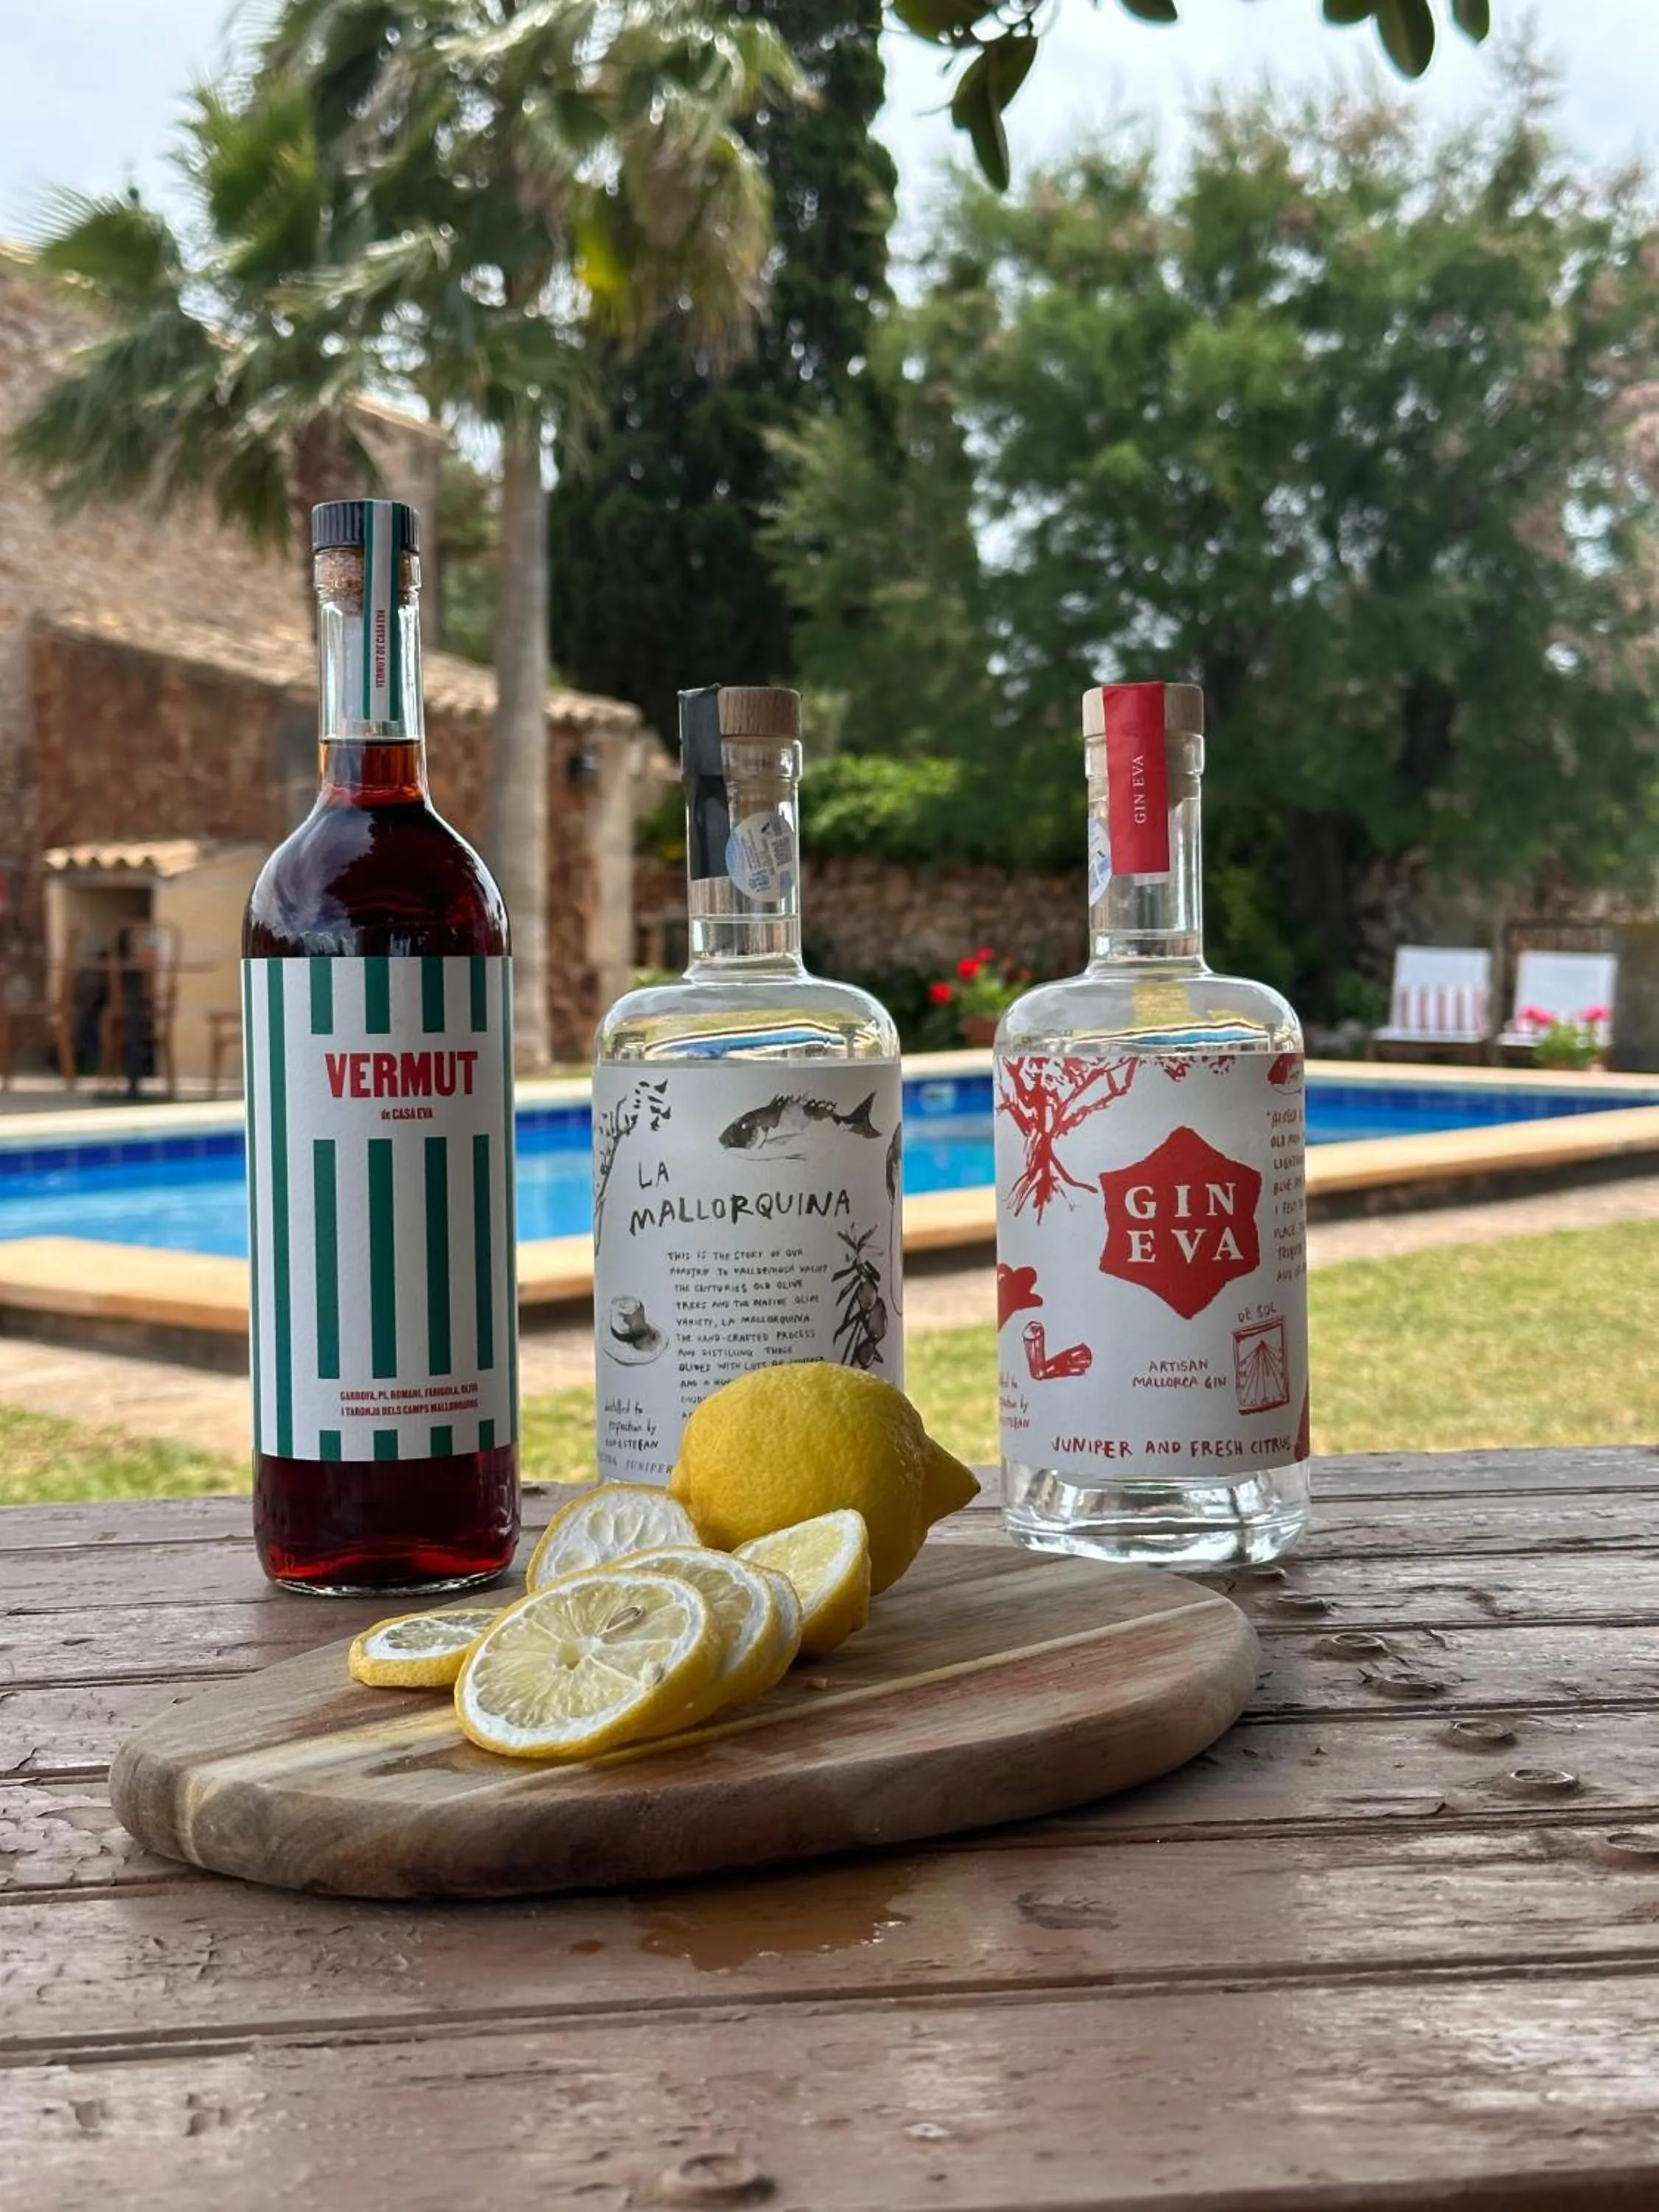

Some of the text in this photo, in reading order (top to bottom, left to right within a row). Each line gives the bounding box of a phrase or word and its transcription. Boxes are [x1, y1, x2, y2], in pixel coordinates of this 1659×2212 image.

[1133, 755, 1146, 824] GIN EVA
[325, 1051, 478, 1098] VERMUT
[381, 1107, 433, 1119] de CASA EVA
[639, 1161, 669, 1189] LA
[1124, 1183, 1236, 1219] GIN
[629, 1189, 850, 1237] MALLORQUINA
[1127, 1227, 1244, 1264] EVA
[667, 1251, 689, 1261] THIS
[713, 1251, 730, 1260] THE
[675, 1284, 689, 1293] THE
[776, 1279, 802, 1290] OLIVE
[675, 1301, 706, 1310] TREES
[1238, 1301, 1276, 1323] DE SOL
[721, 1318, 735, 1326] LA
[676, 1332, 692, 1342] THE
[776, 1329, 815, 1340] PROCESS
[1148, 1359, 1209, 1373] ARTISAN
[1132, 1376, 1227, 1389] MALLORCA GIN
[403, 1404, 429, 1414] CAMPS
[647, 1417, 657, 1436] by
[1051, 1436, 1292, 1458] JUNIPER AND FRESH CITRUS
